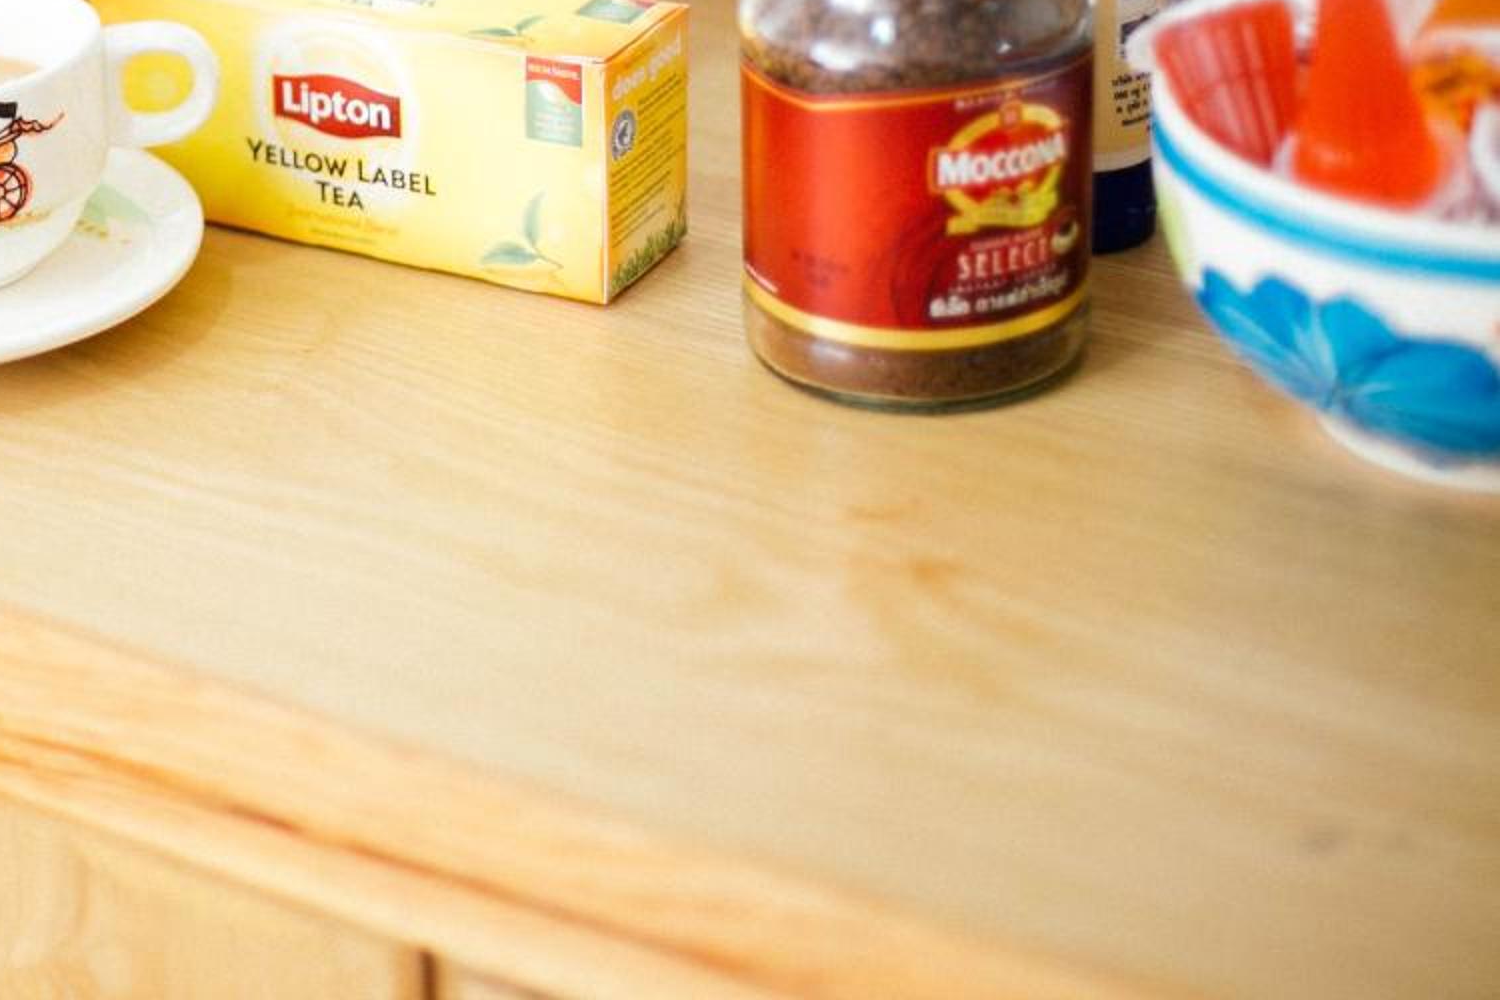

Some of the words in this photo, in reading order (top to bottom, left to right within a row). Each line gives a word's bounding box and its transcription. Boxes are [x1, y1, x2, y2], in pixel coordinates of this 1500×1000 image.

[281, 80, 391, 130] Lipton
[247, 137, 348, 178] YELLOW
[357, 158, 437, 196] LABEL
[315, 180, 365, 210] TEA
[956, 237, 1049, 281] SELECT
